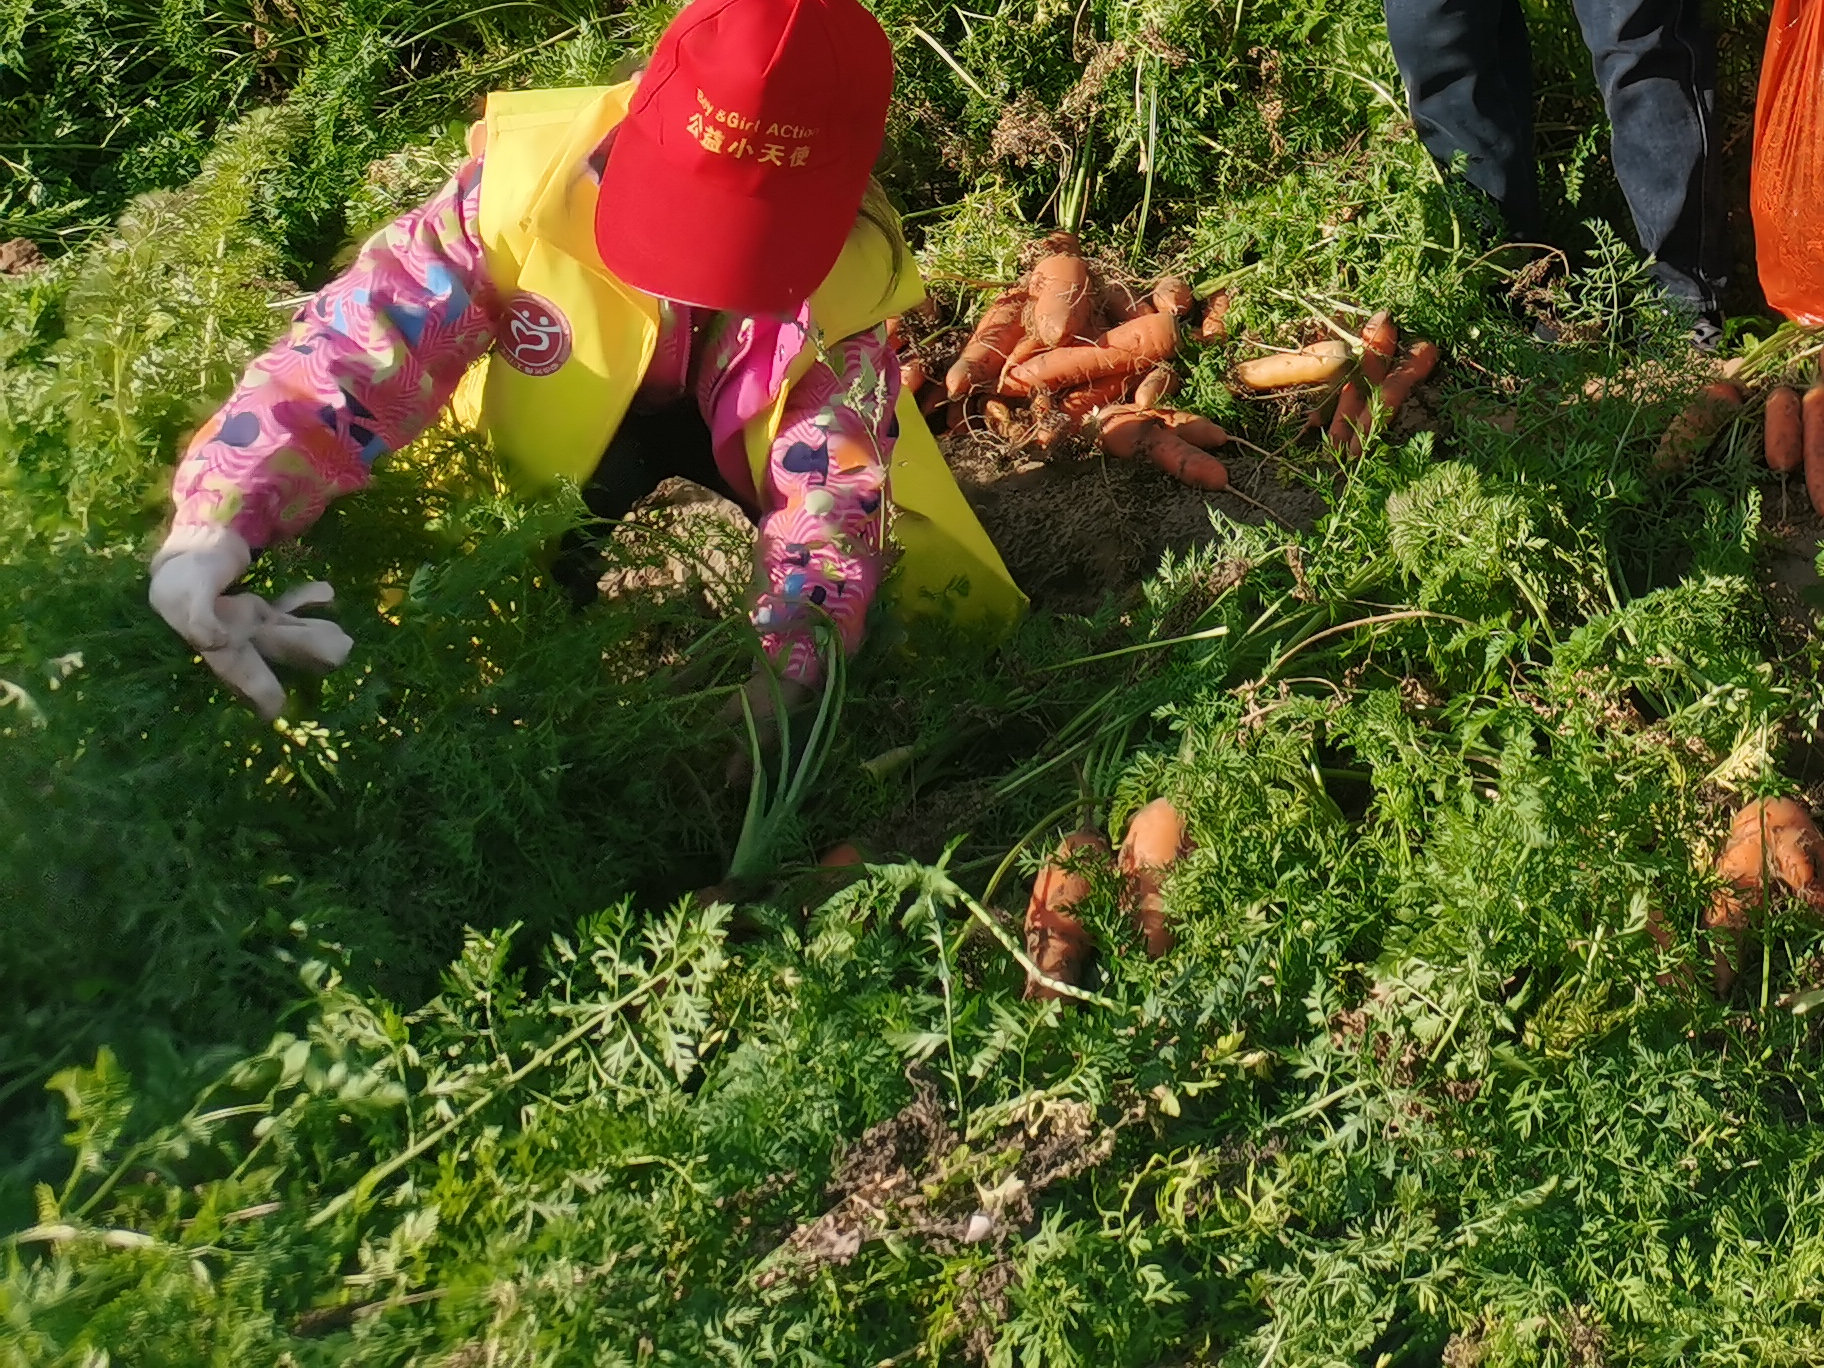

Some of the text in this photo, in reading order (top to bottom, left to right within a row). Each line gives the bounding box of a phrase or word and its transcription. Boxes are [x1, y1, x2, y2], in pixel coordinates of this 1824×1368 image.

[686, 112, 811, 168] 公益小天使
